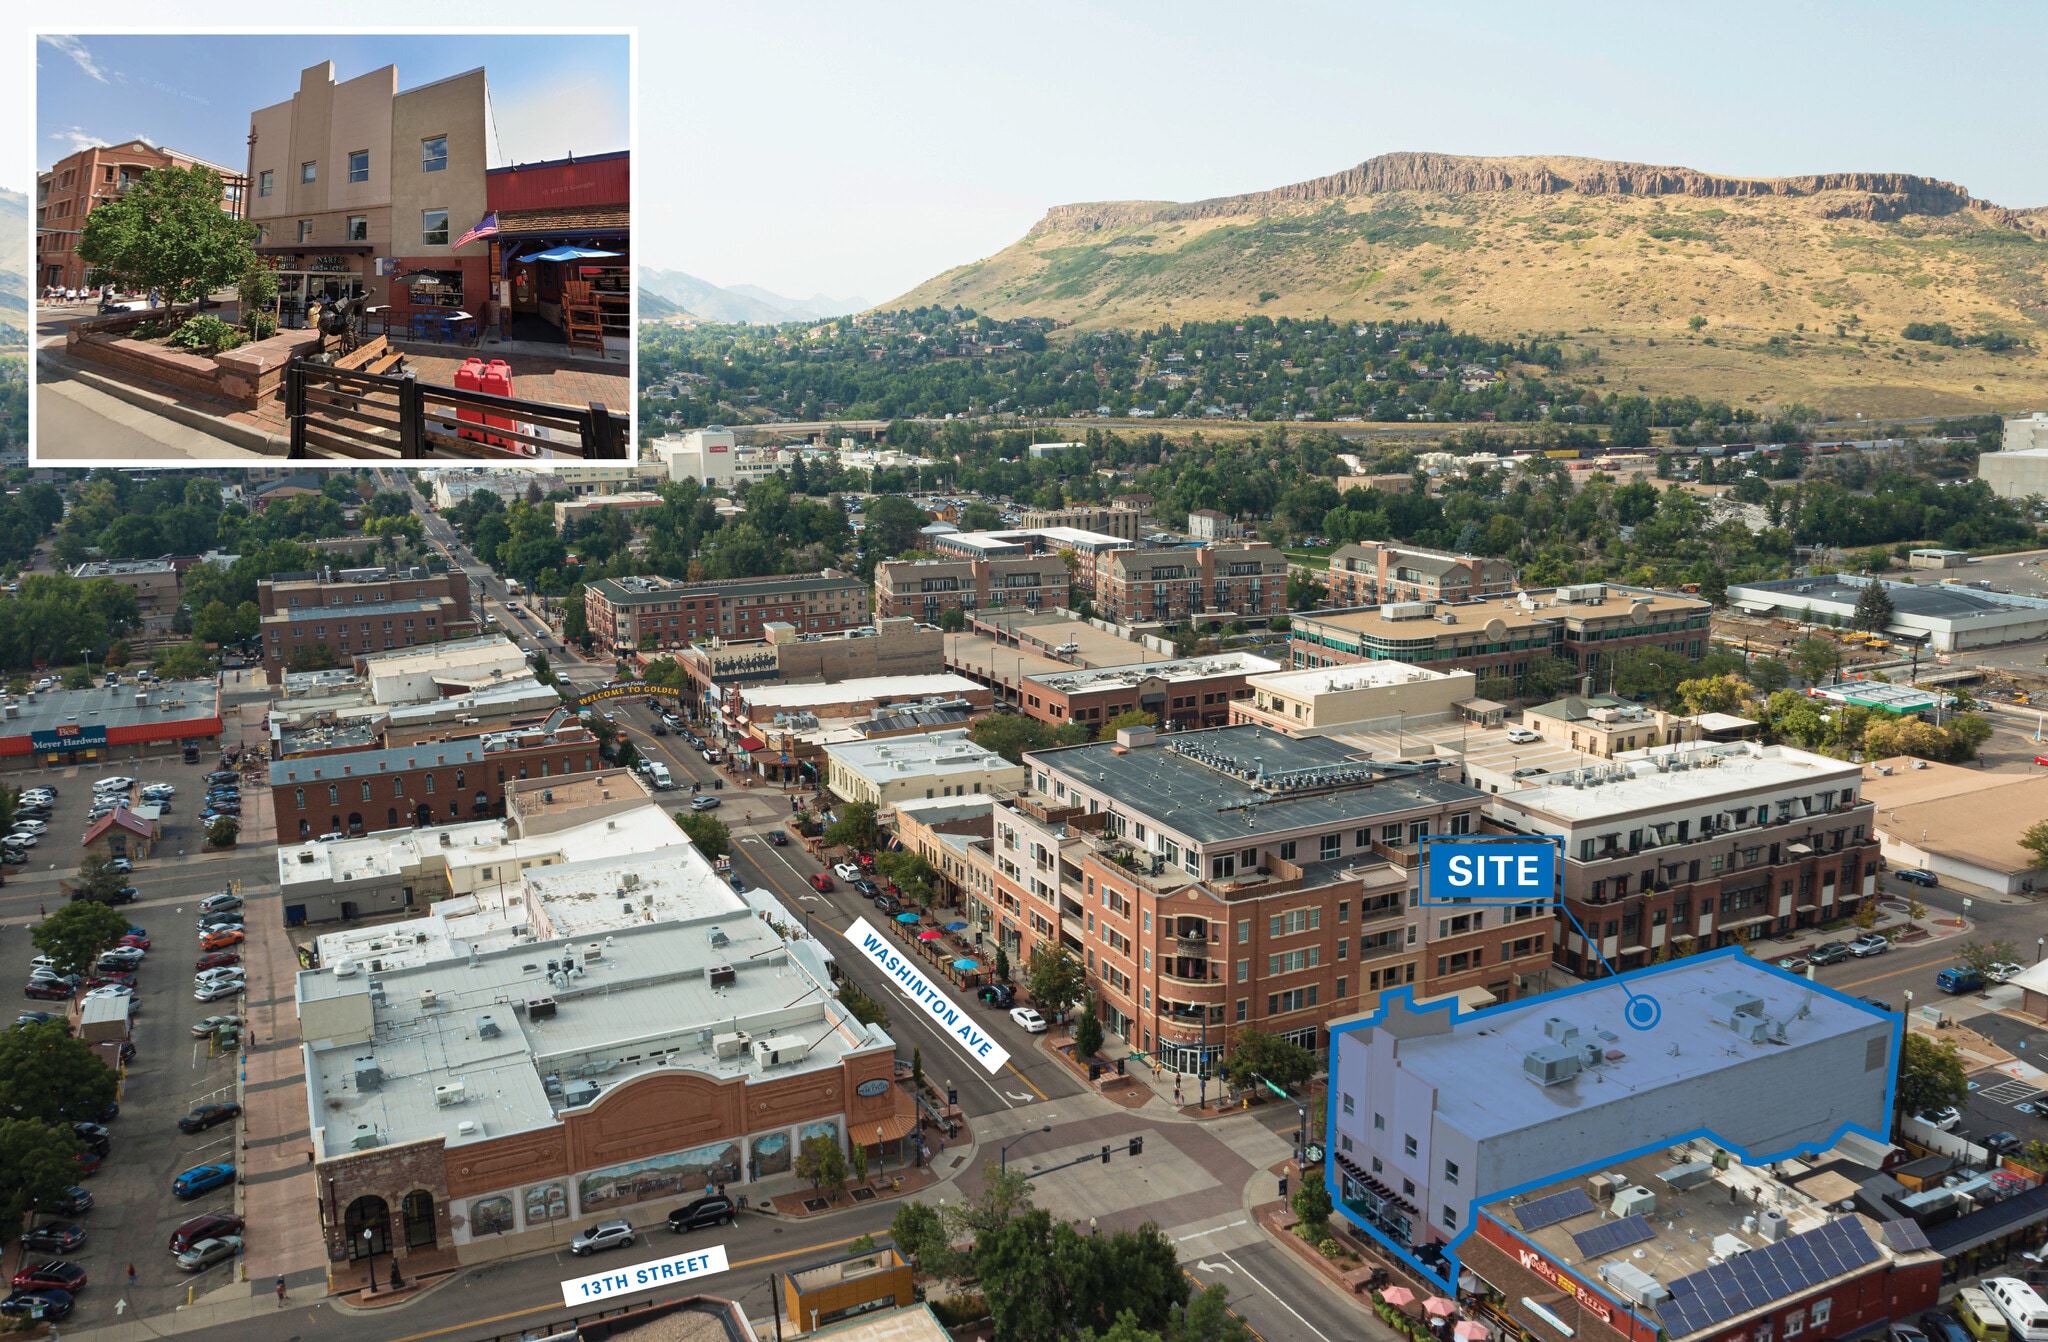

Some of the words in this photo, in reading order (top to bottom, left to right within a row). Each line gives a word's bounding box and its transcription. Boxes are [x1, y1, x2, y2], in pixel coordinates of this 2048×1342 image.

[578, 687, 625, 706] WELCOME
[627, 686, 641, 694] TO
[643, 685, 680, 696] GOLDEN
[59, 727, 79, 737] Best
[32, 741, 62, 750] Meyer
[62, 736, 107, 747] Hardware
